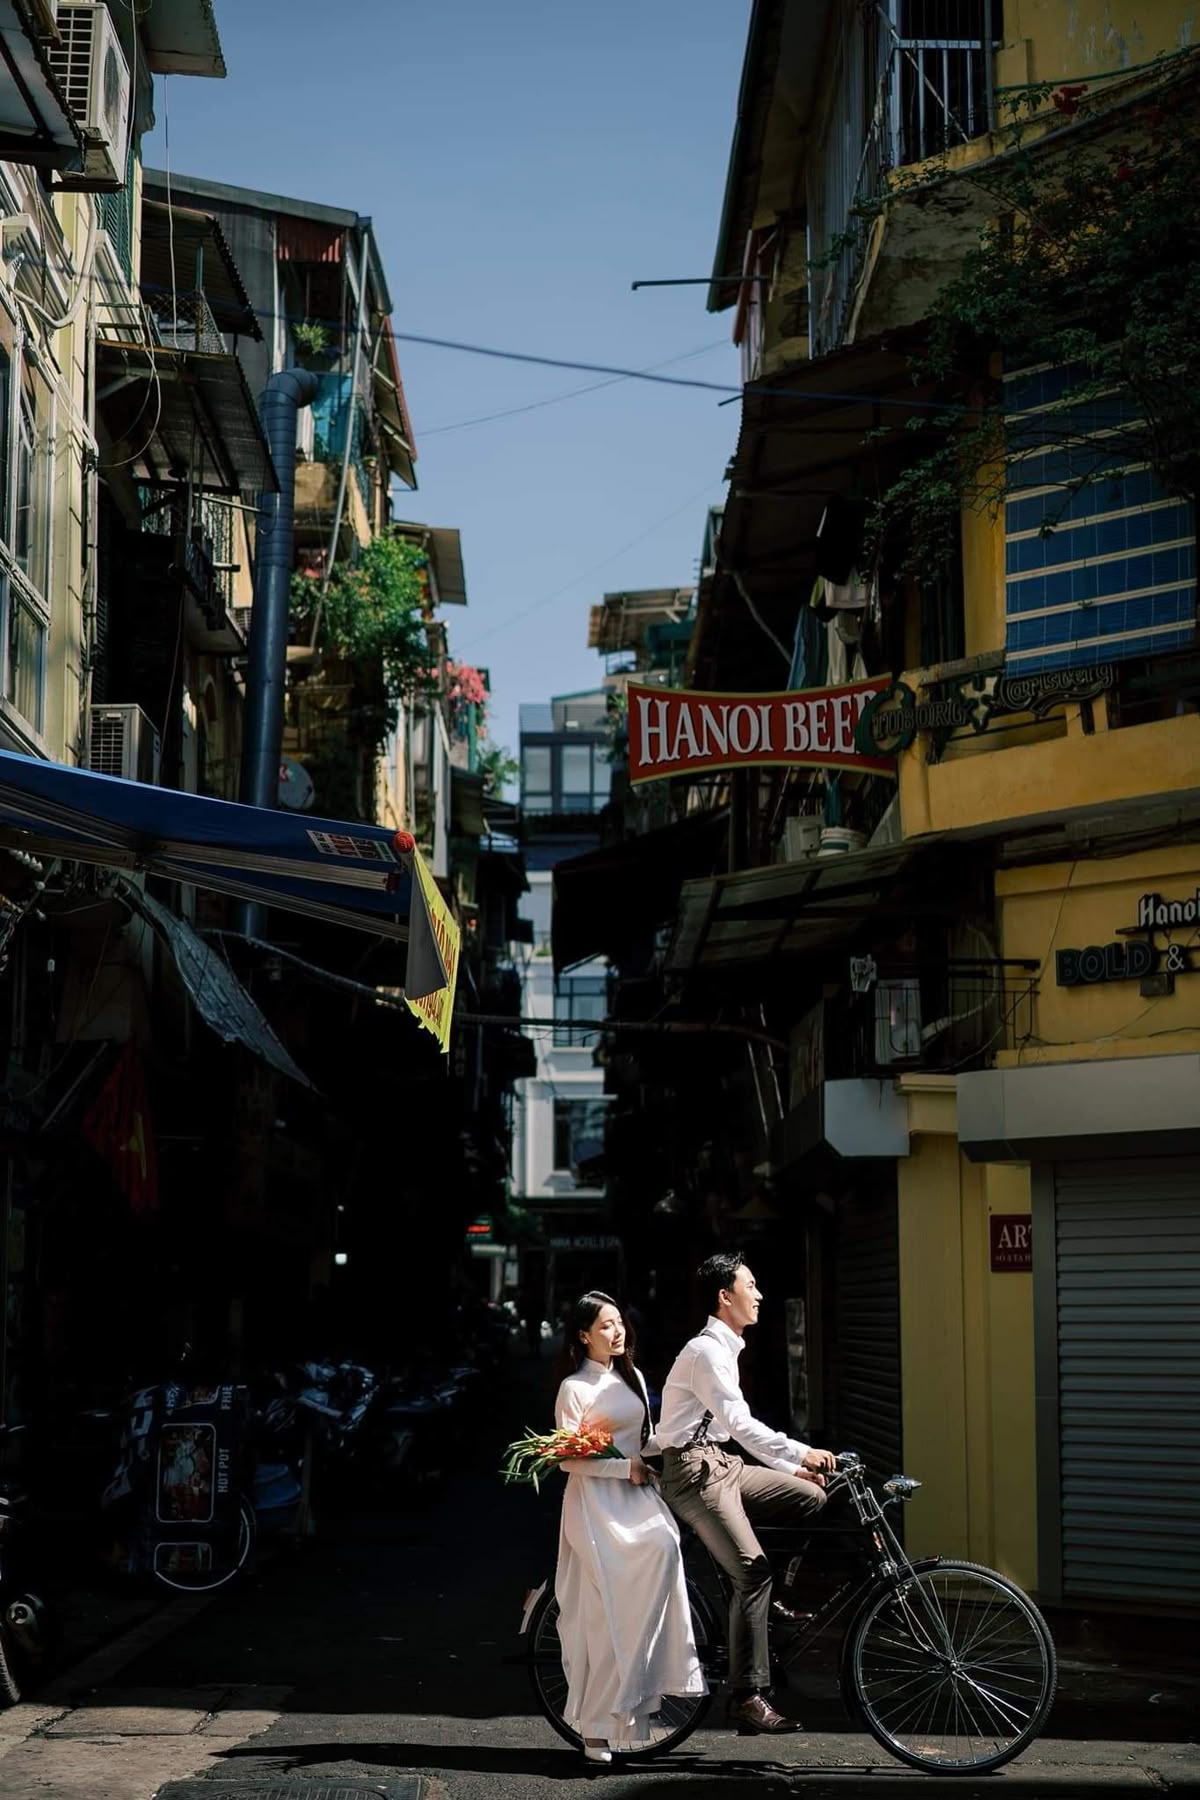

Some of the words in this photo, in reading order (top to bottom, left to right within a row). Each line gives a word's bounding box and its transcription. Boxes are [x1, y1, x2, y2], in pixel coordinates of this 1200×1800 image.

[636, 695, 774, 767] HANOI
[1056, 941, 1153, 986] BOLD
[1167, 944, 1186, 972] &
[218, 1448, 231, 1470] POT
[217, 1471, 231, 1493] HOT
